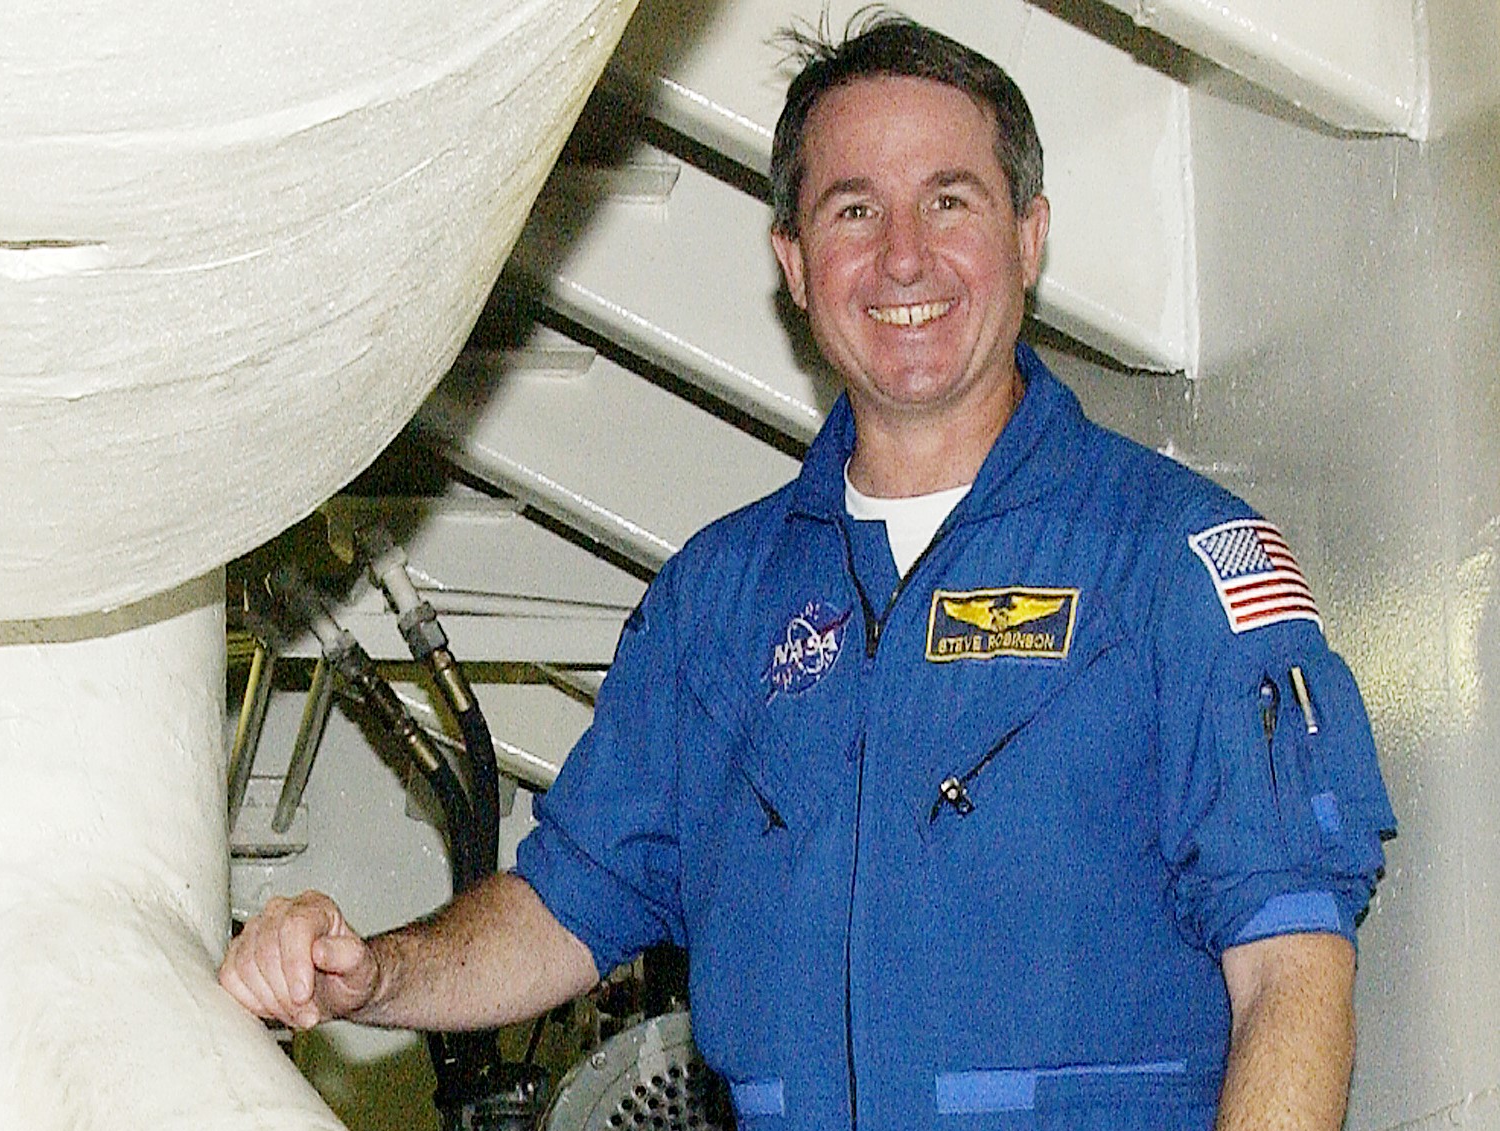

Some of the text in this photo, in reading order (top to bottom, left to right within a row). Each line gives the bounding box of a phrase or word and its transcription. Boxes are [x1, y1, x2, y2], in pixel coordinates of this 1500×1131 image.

[773, 629, 839, 668] NASA
[937, 631, 1056, 654] STEVE ROBINSON
